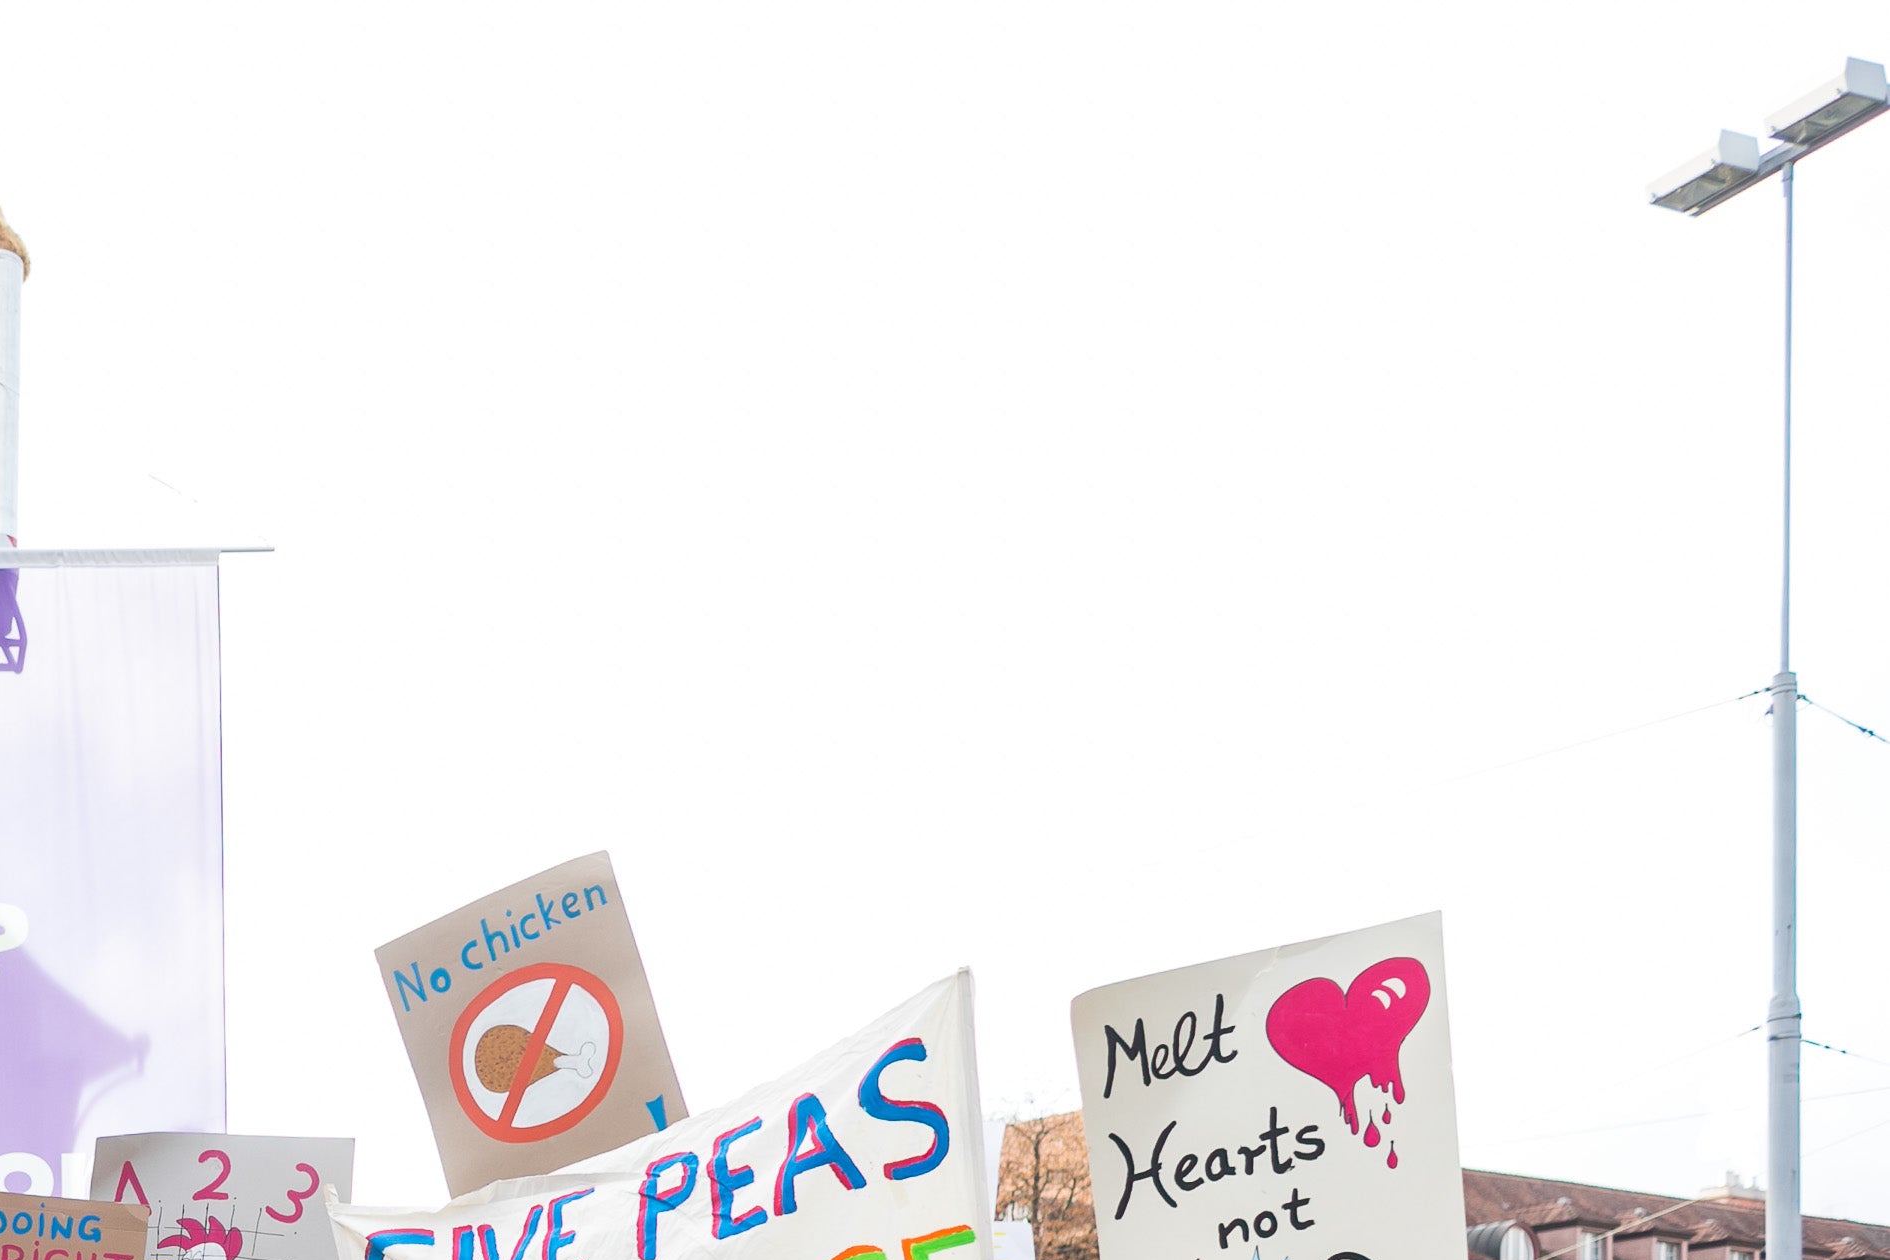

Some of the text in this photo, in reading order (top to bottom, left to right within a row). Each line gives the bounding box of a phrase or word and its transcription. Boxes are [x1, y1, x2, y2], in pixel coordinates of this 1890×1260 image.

[393, 884, 608, 1012] No chicken
[1103, 994, 1238, 1099] Melt
[1108, 1106, 1326, 1220] Hearts
[1217, 1188, 1315, 1249] not
